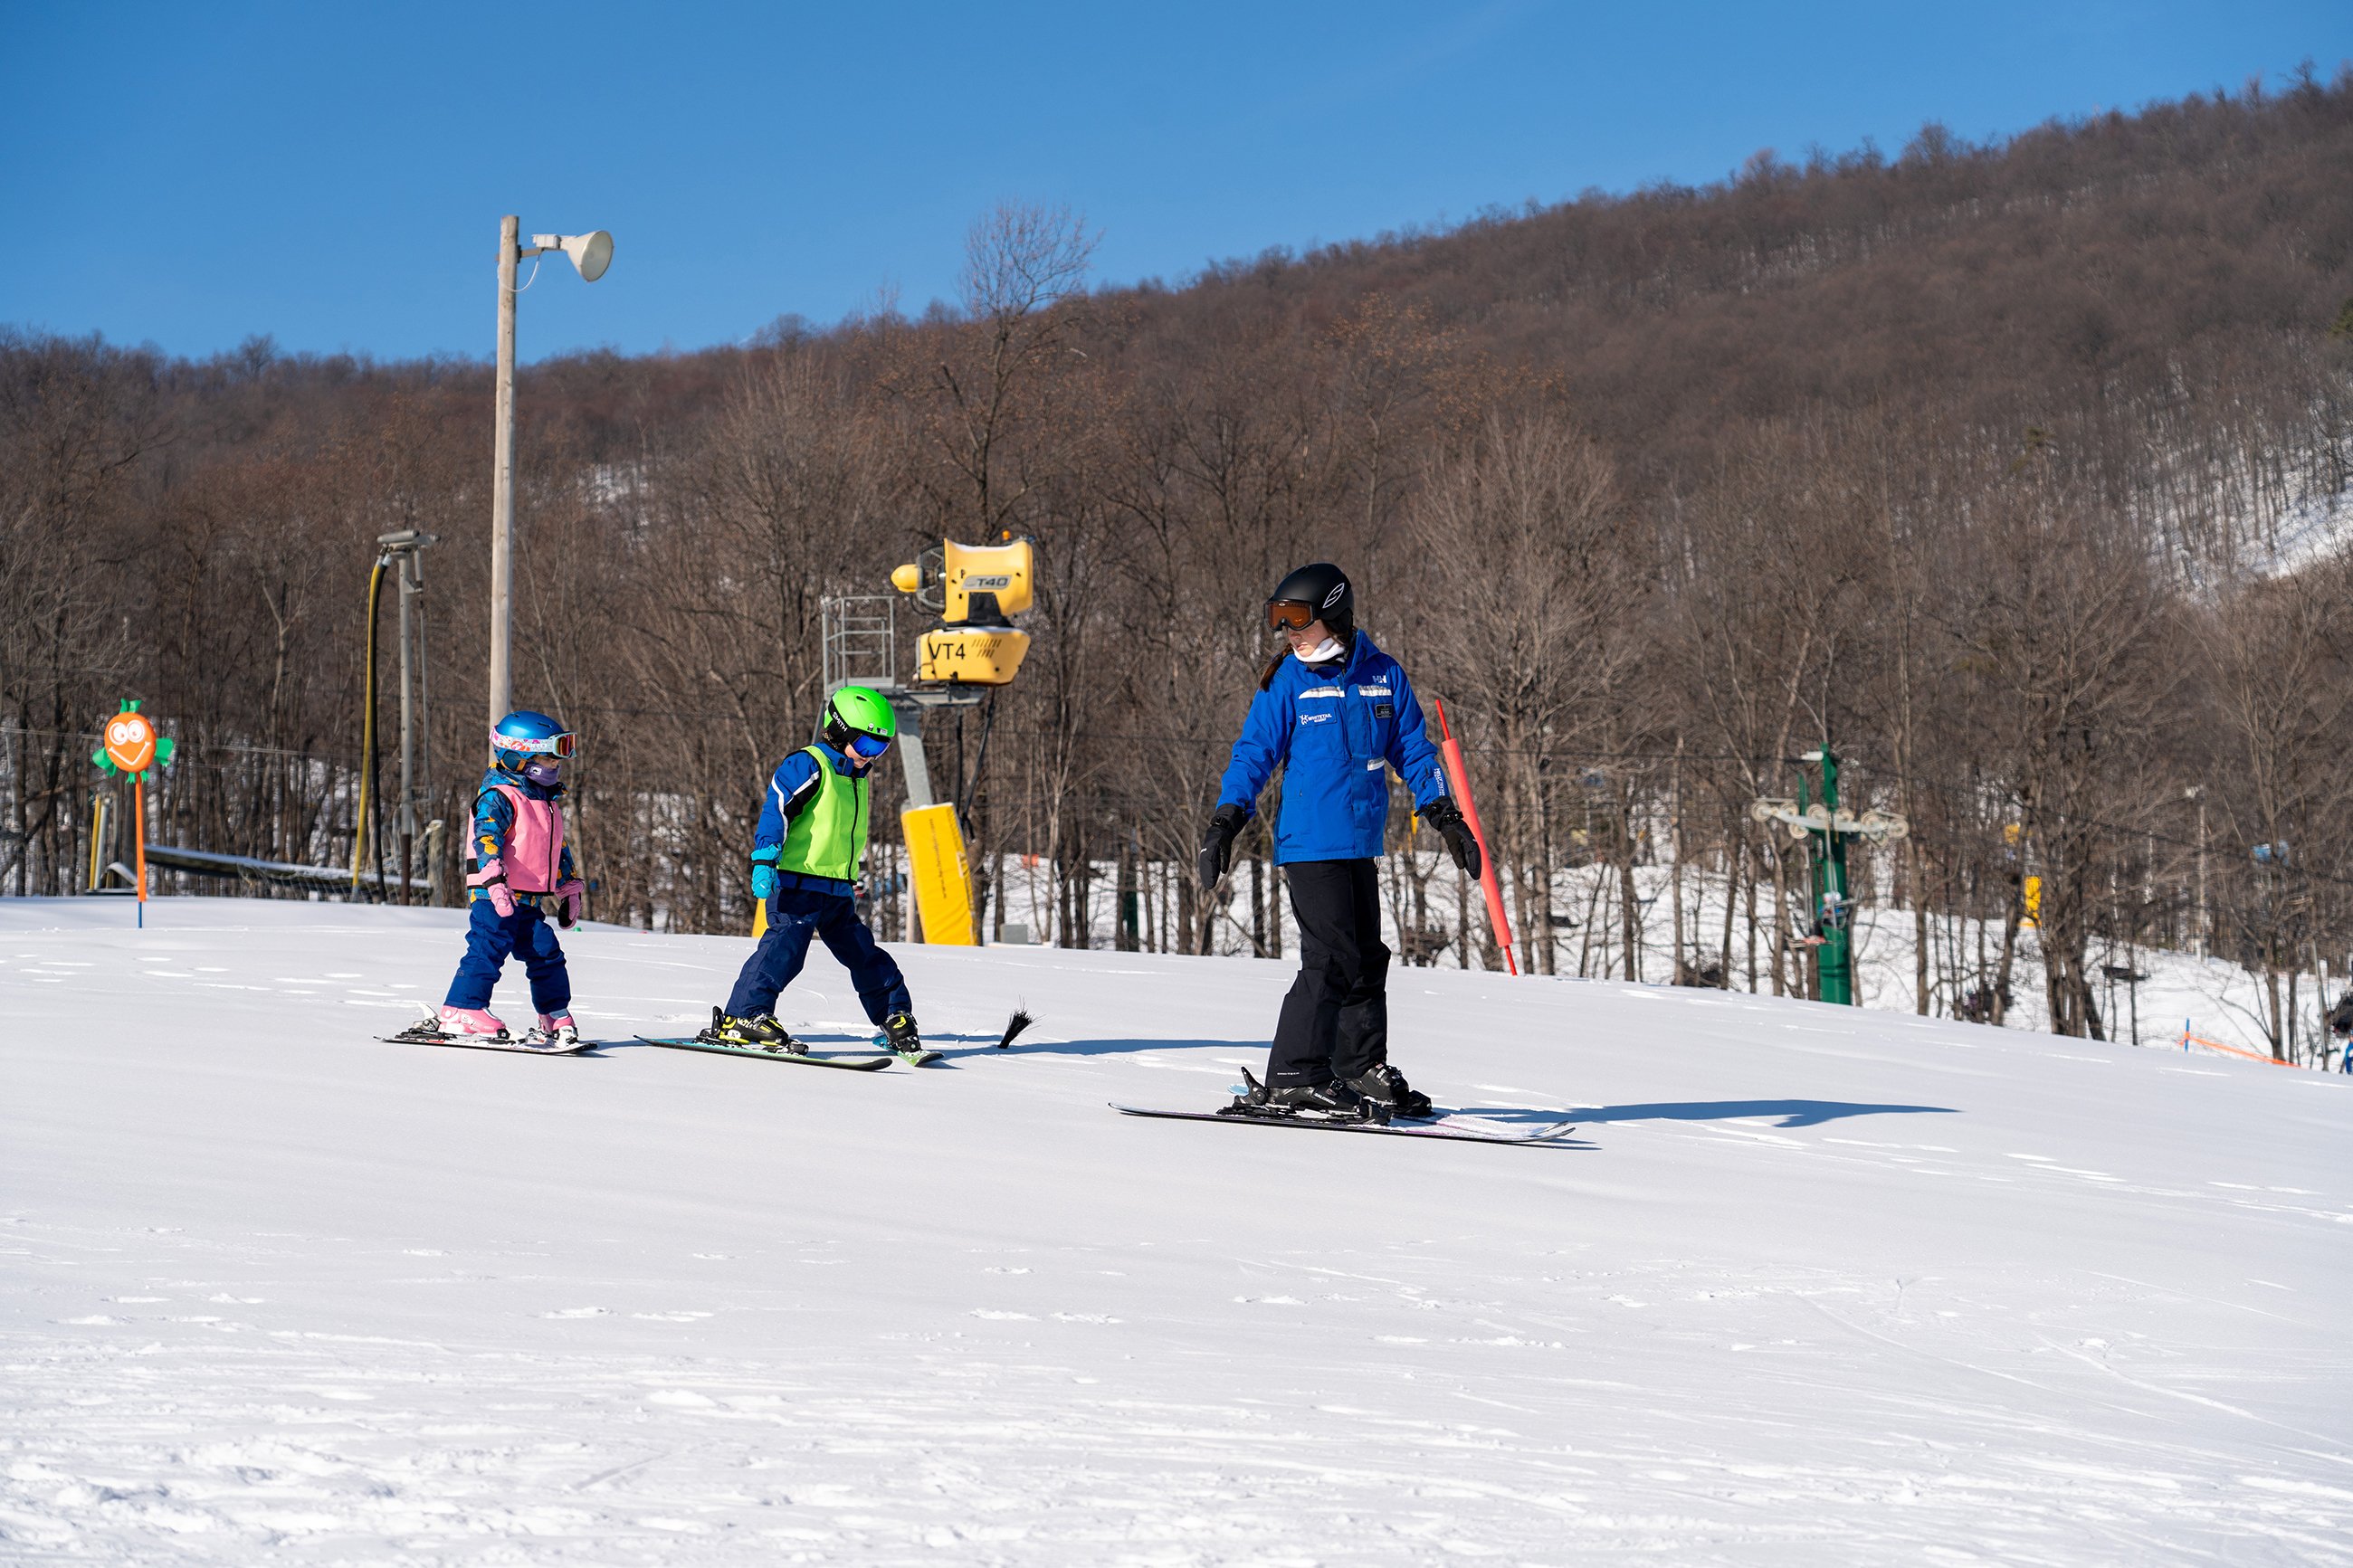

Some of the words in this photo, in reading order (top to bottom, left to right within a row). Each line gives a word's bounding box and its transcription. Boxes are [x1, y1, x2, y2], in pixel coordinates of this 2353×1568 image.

[976, 577, 1008, 587] T40
[929, 642, 966, 660] VT4
[832, 711, 848, 732] SMITH
[1313, 1092, 1337, 1106] SALOMON
